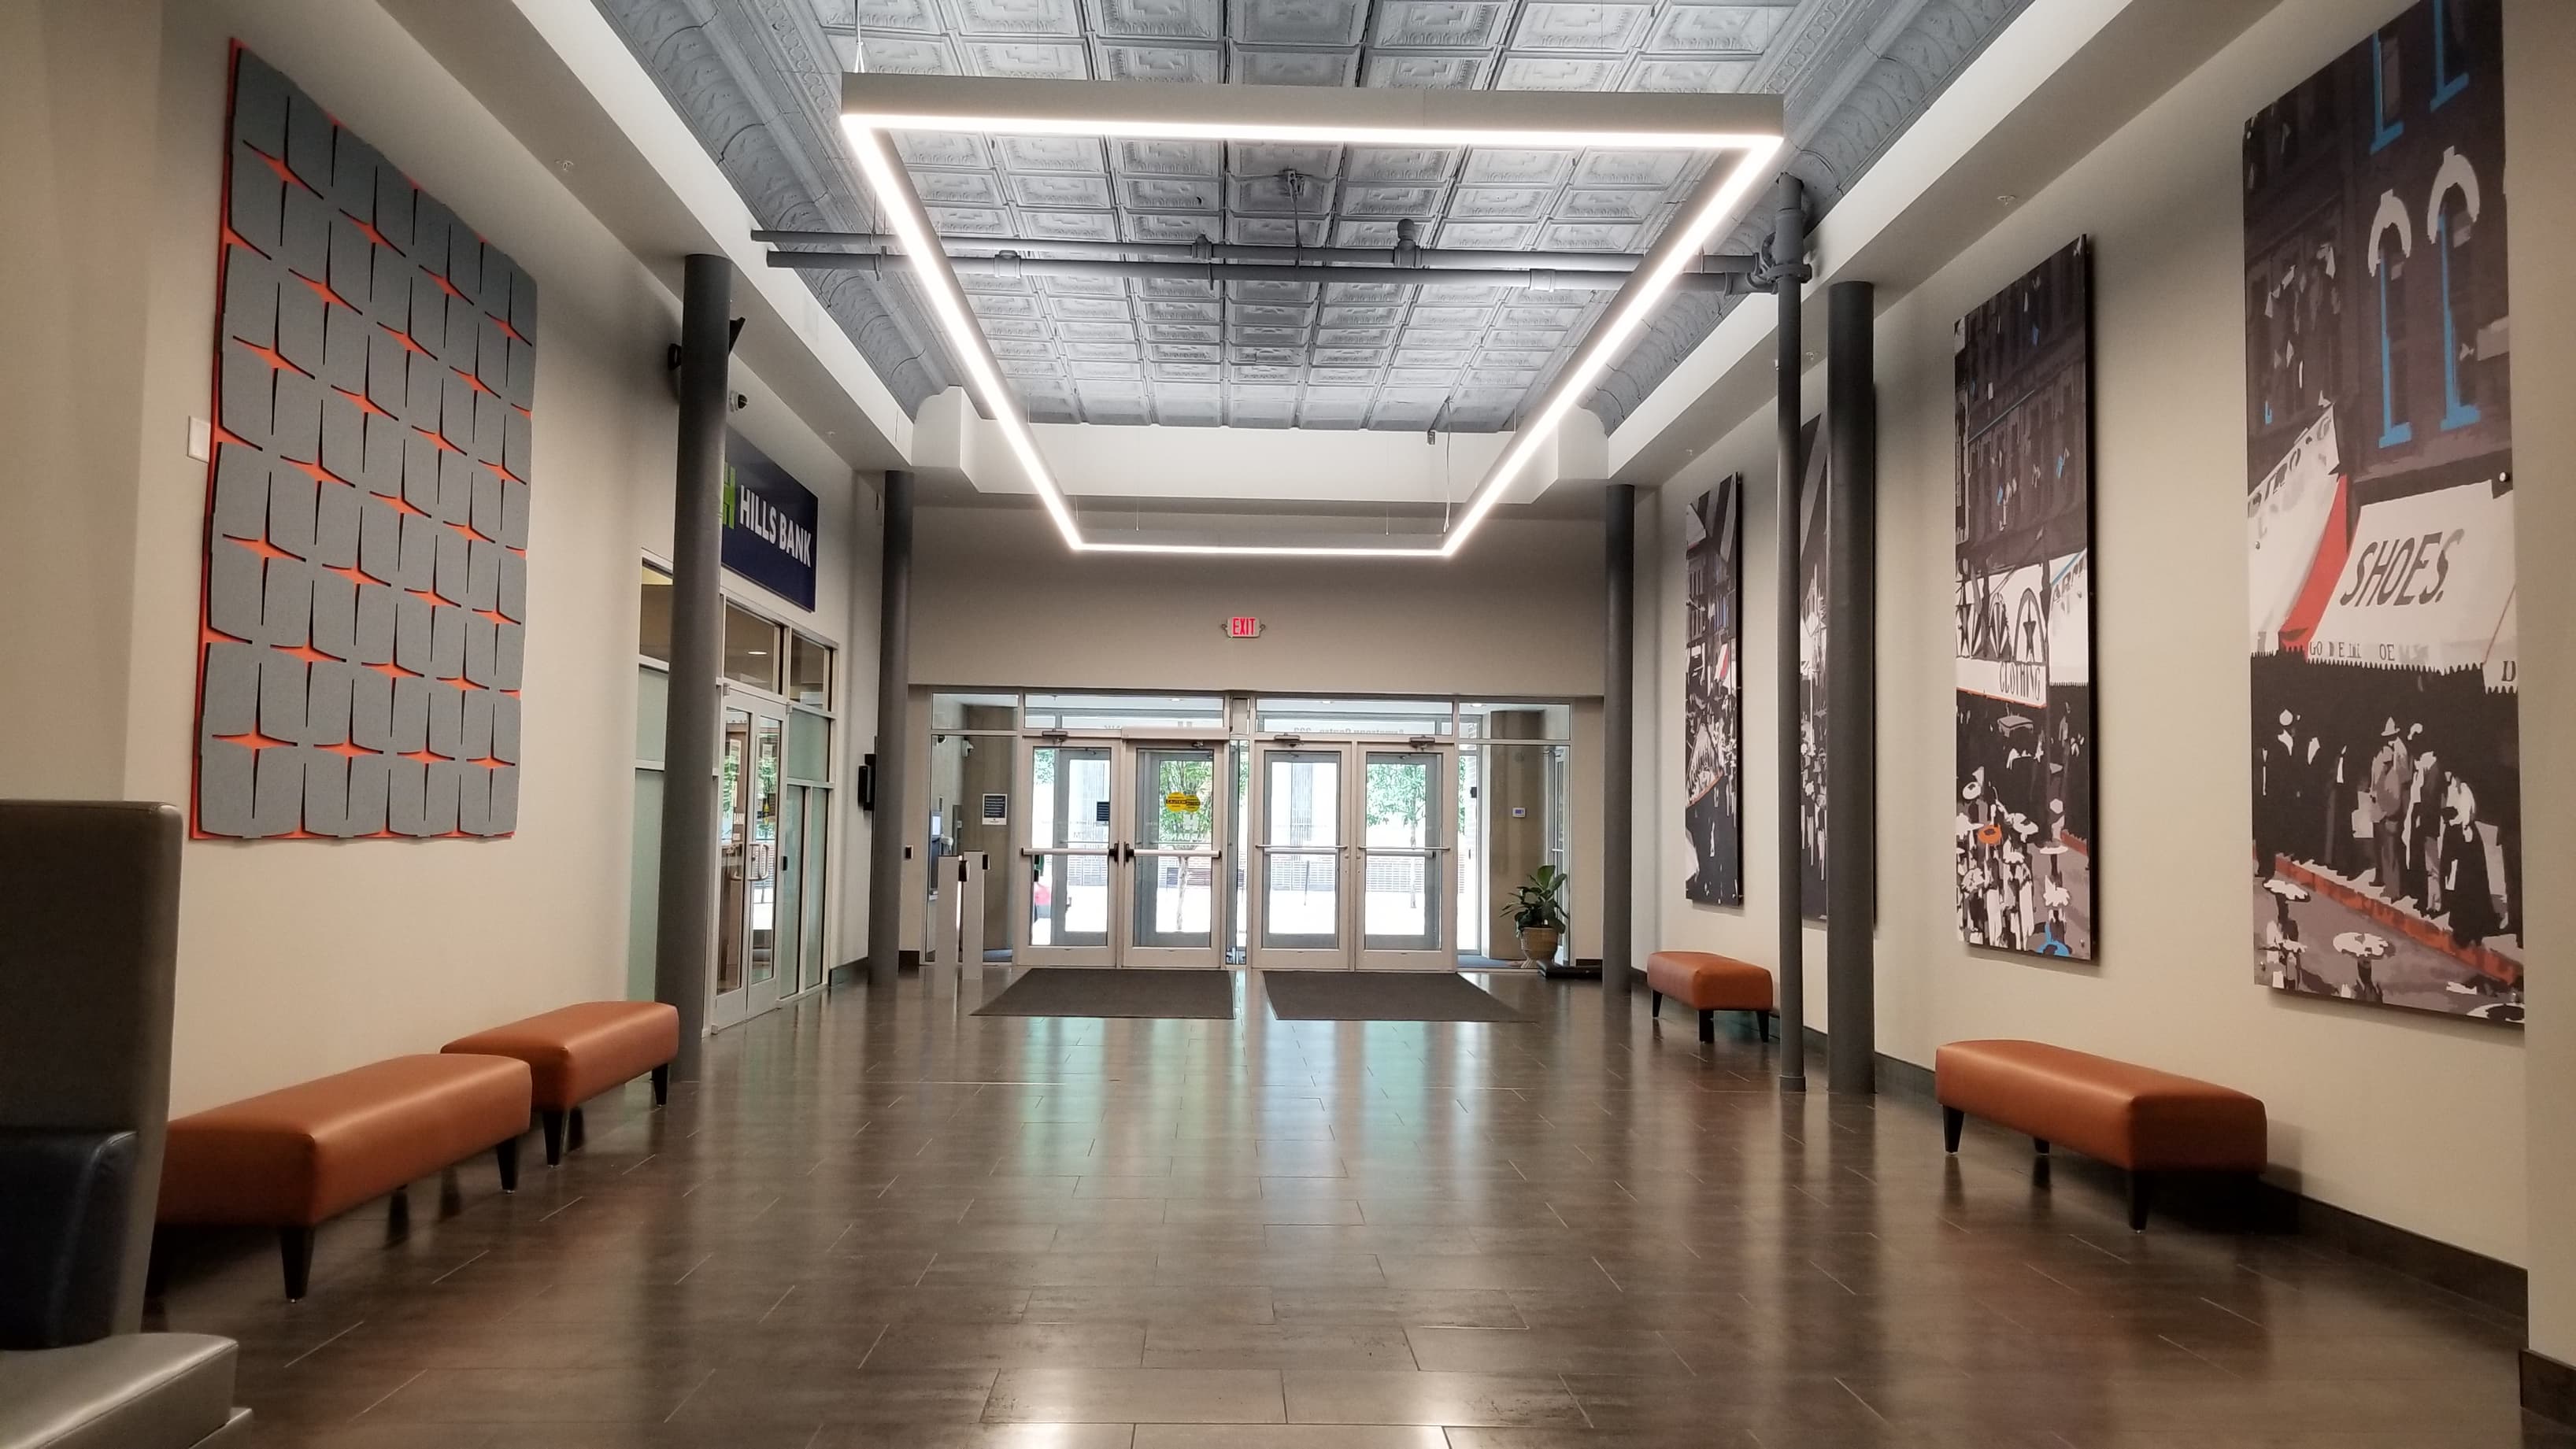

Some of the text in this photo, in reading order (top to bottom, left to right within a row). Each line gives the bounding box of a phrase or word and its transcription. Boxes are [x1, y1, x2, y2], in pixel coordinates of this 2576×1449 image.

[740, 485, 811, 567] HILLS BANK
[1233, 618, 1256, 635] EXIT
[1999, 661, 2041, 701] CLOTHING
